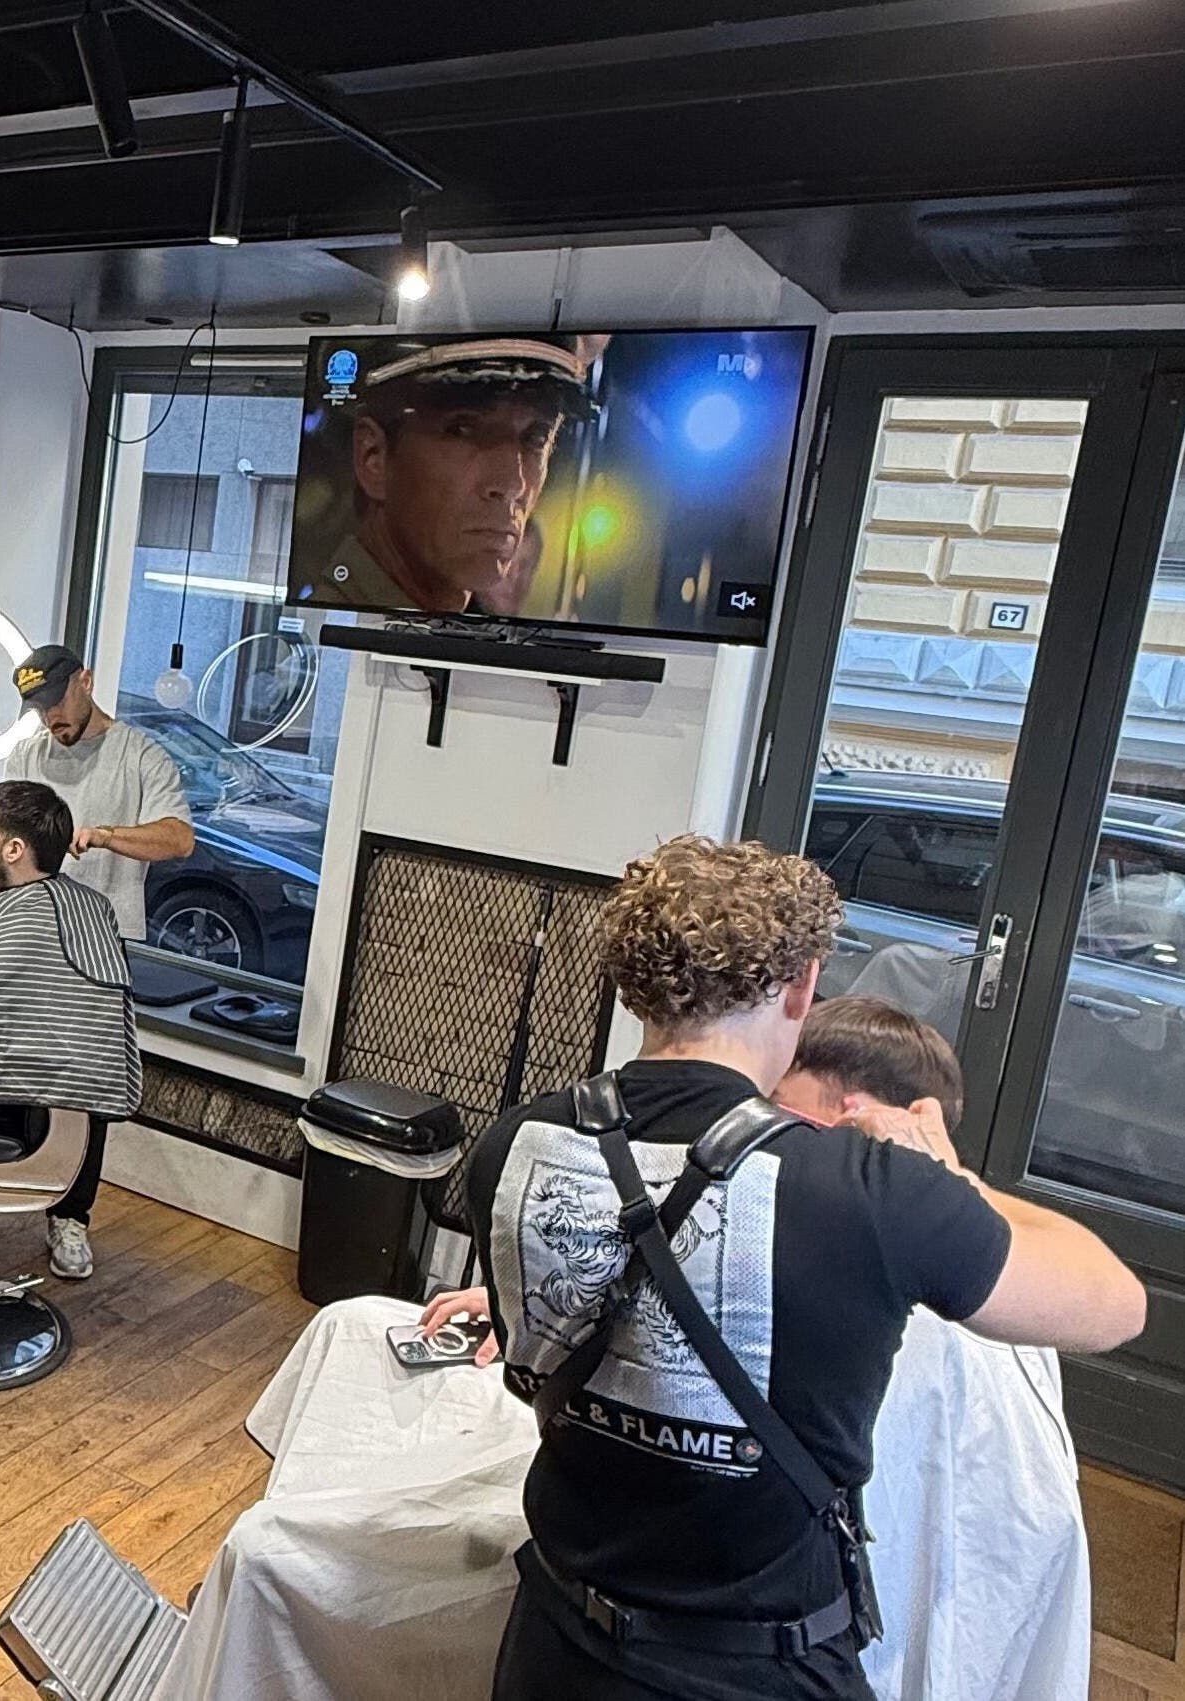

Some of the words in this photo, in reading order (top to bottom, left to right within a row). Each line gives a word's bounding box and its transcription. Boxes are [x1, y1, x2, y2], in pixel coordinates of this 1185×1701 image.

[998, 609, 1021, 622] 67
[589, 1403, 611, 1427] &
[620, 1413, 733, 1461] FLAME
